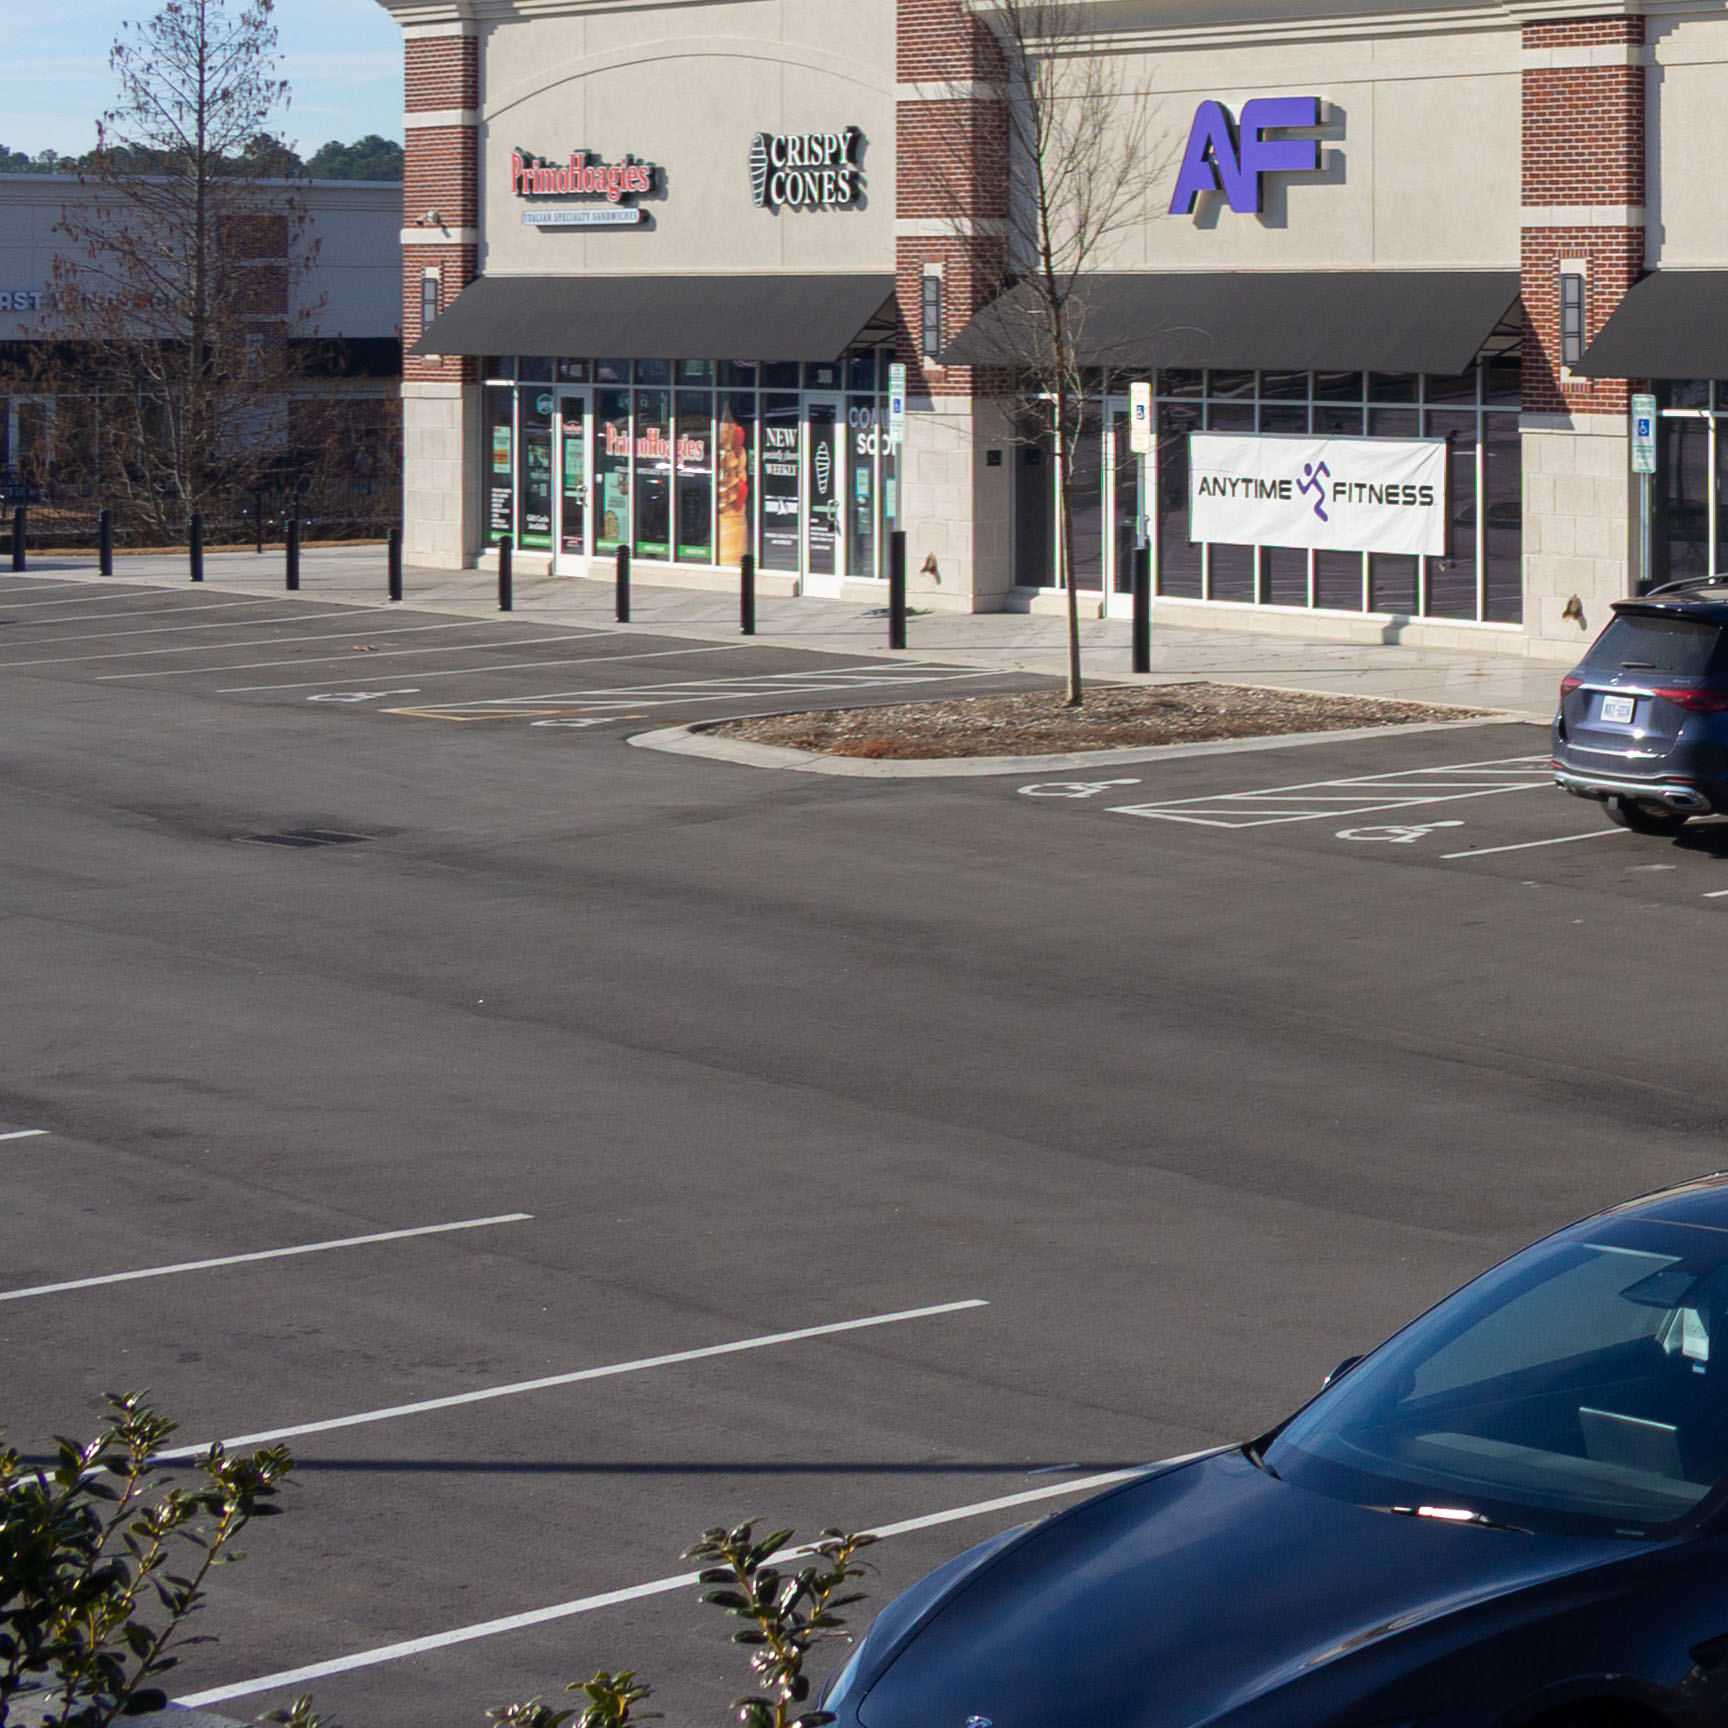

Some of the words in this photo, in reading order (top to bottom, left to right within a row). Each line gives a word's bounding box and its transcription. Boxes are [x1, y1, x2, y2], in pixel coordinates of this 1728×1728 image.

[770, 132, 852, 167] CRISPY
[1168, 96, 1317, 215] AF
[511, 150, 649, 202] PrimoHoagies
[770, 170, 851, 205] CONES
[765, 428, 798, 447] NEW
[1198, 476, 1292, 500] ANYTIME
[1333, 482, 1434, 506] FITNESS
